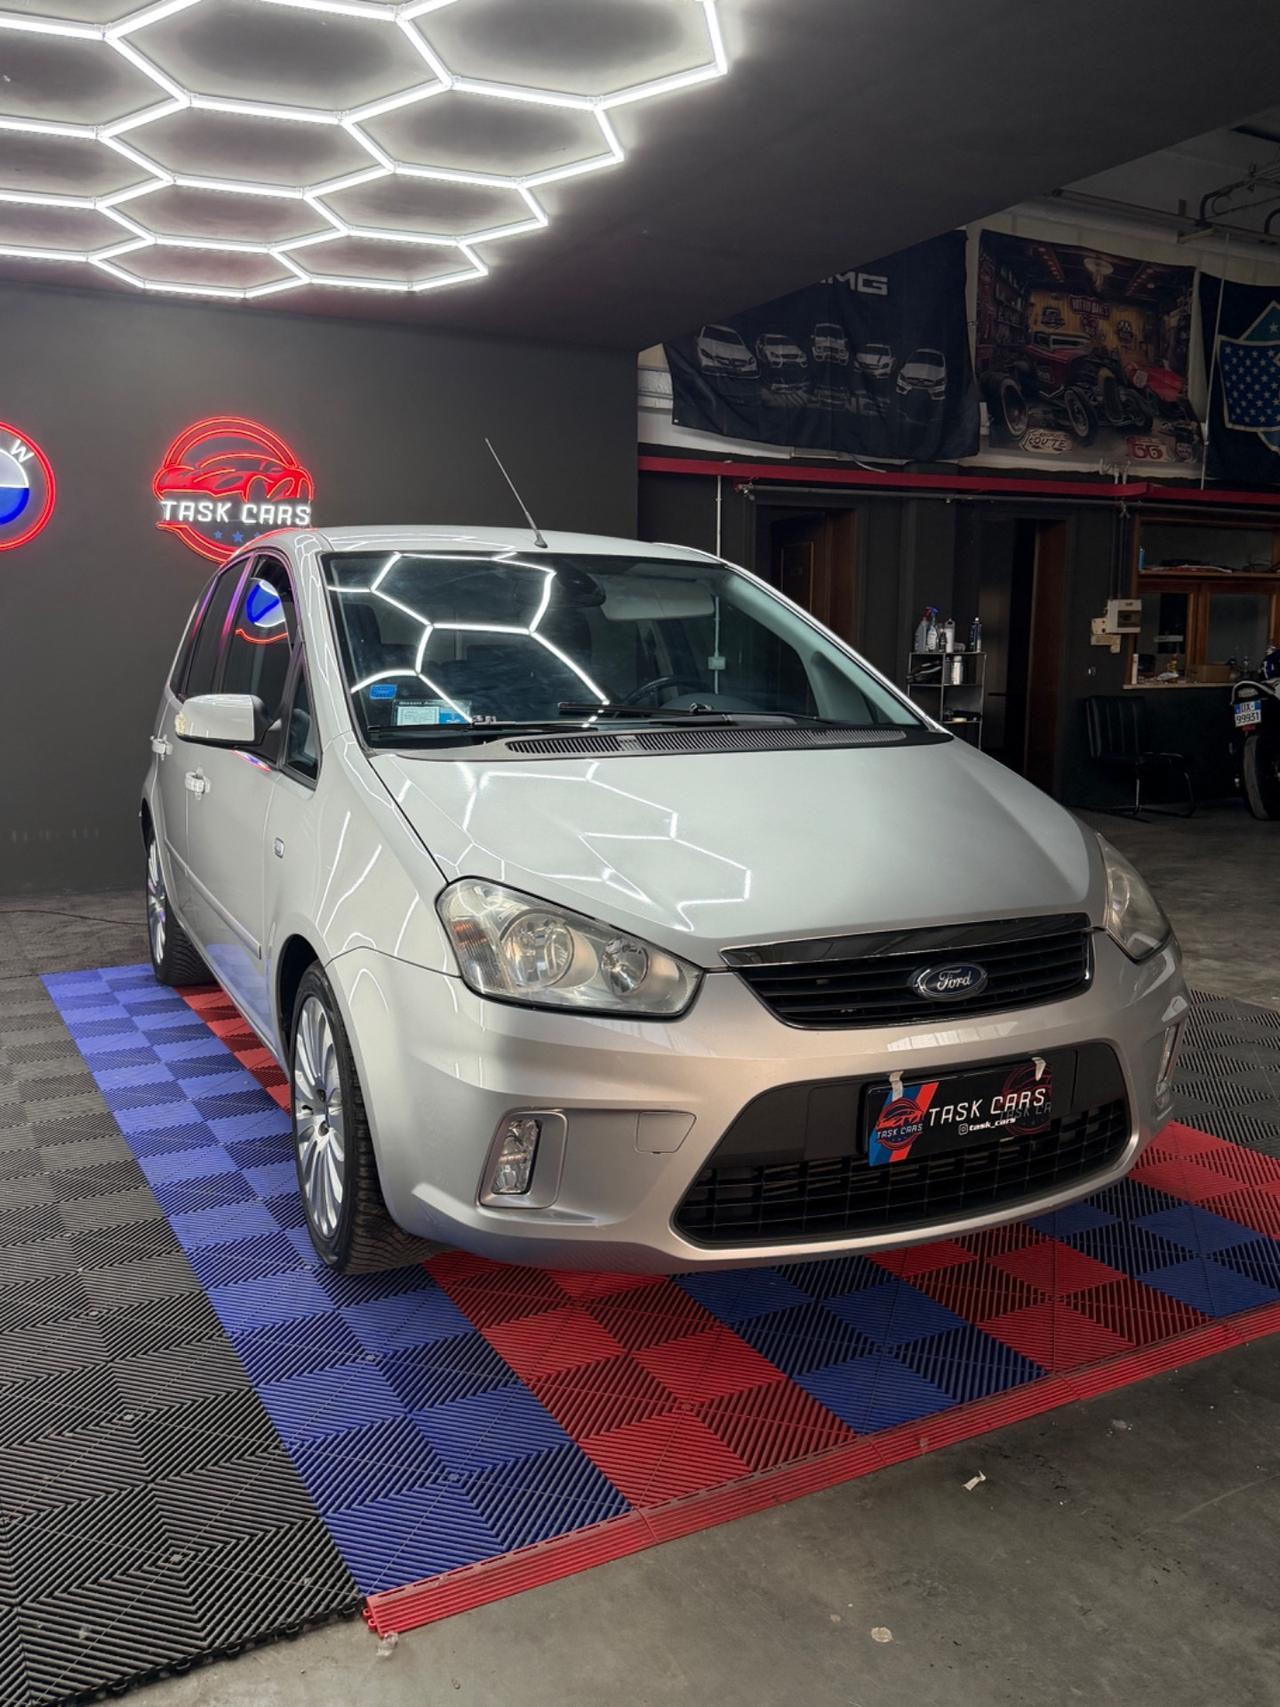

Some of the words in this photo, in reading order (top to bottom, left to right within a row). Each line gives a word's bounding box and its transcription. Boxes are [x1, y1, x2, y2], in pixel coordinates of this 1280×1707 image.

[820, 271, 888, 296] MG
[160, 500, 232, 523] TASK
[241, 503, 311, 526] CARS
[937, 968, 972, 991] Ford
[928, 1098, 984, 1127] TASK
[990, 1087, 1047, 1115] CARS
[876, 1127, 899, 1139] TASK
[900, 1123, 923, 1135] CARS
[969, 1116, 1017, 1132] task_cars
